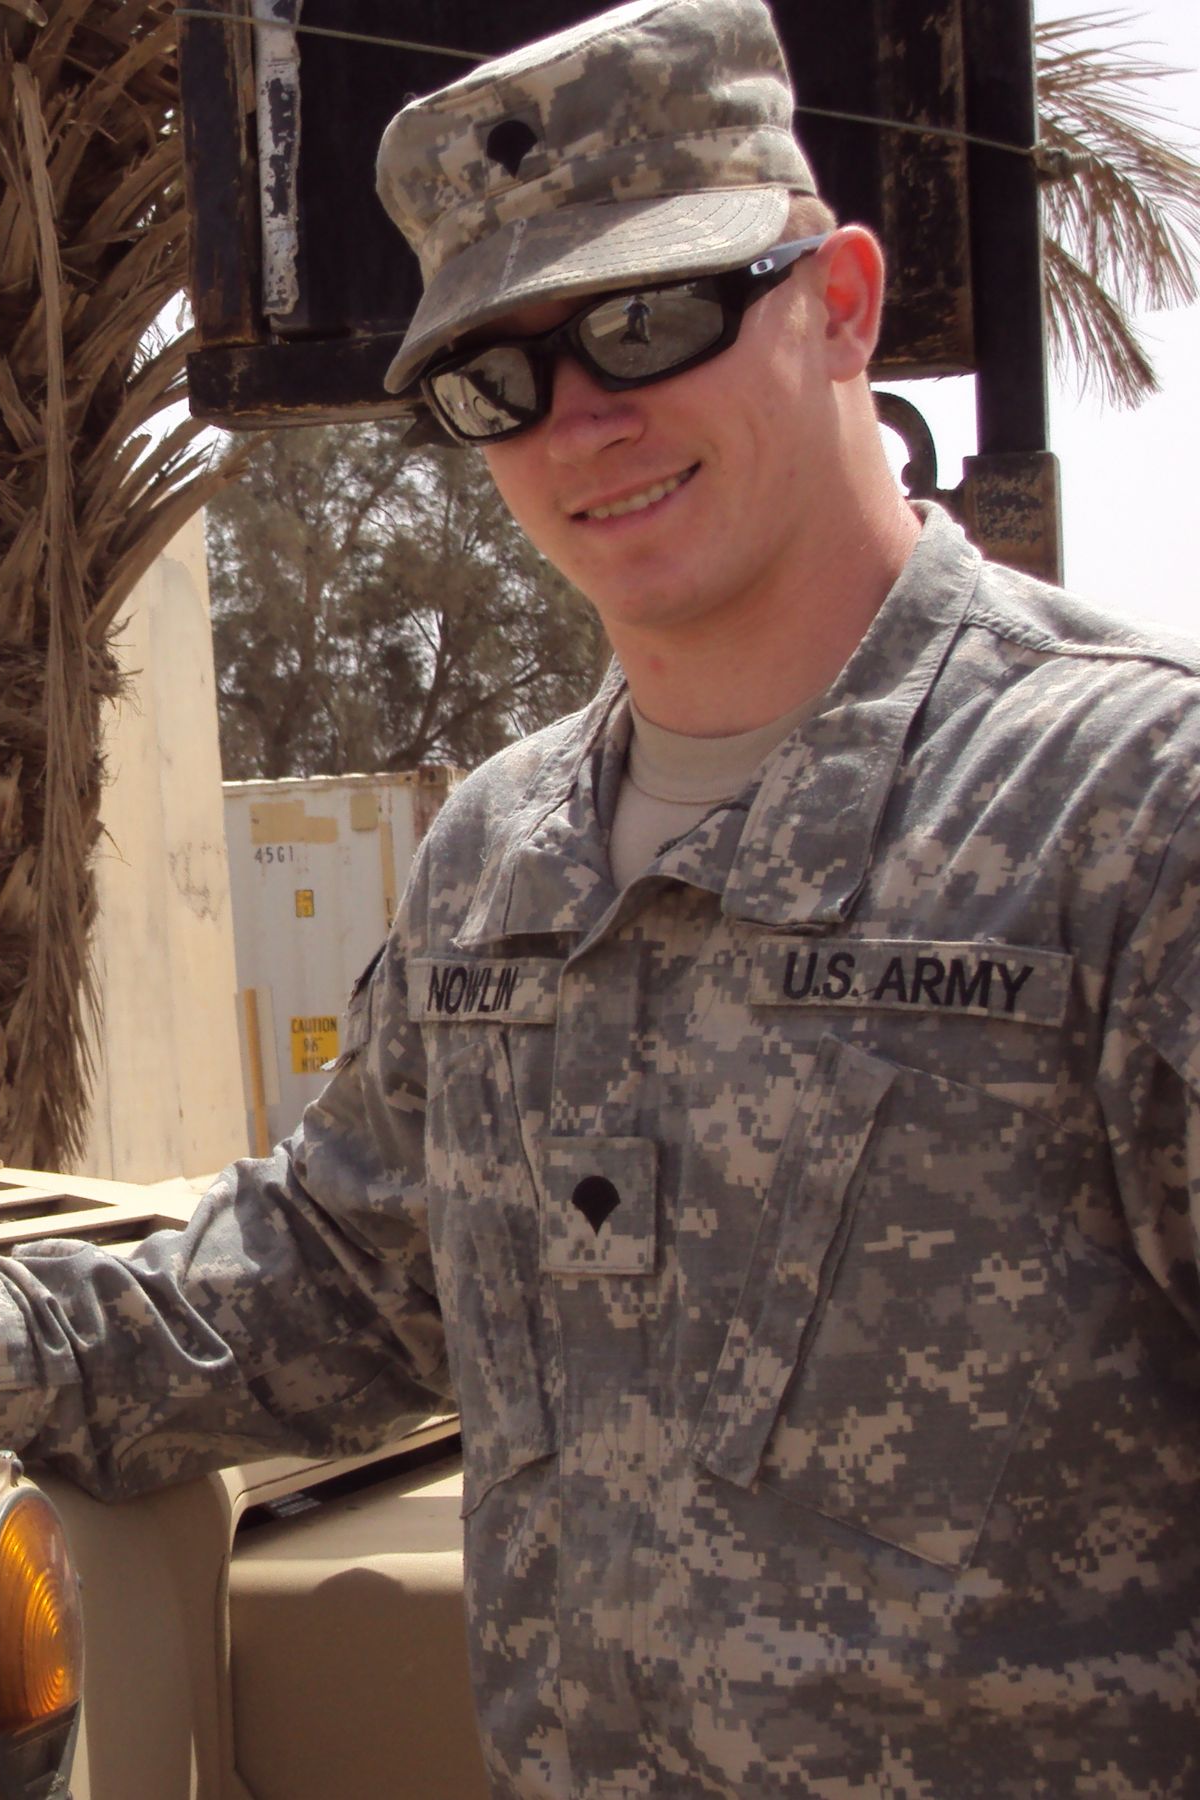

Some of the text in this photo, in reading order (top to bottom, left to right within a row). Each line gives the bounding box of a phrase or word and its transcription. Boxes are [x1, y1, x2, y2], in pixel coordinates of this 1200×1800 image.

[427, 965, 519, 1015] NOWLIN
[783, 951, 1034, 1013] U.S. ARMY
[291, 1018, 337, 1033] CAUTION
